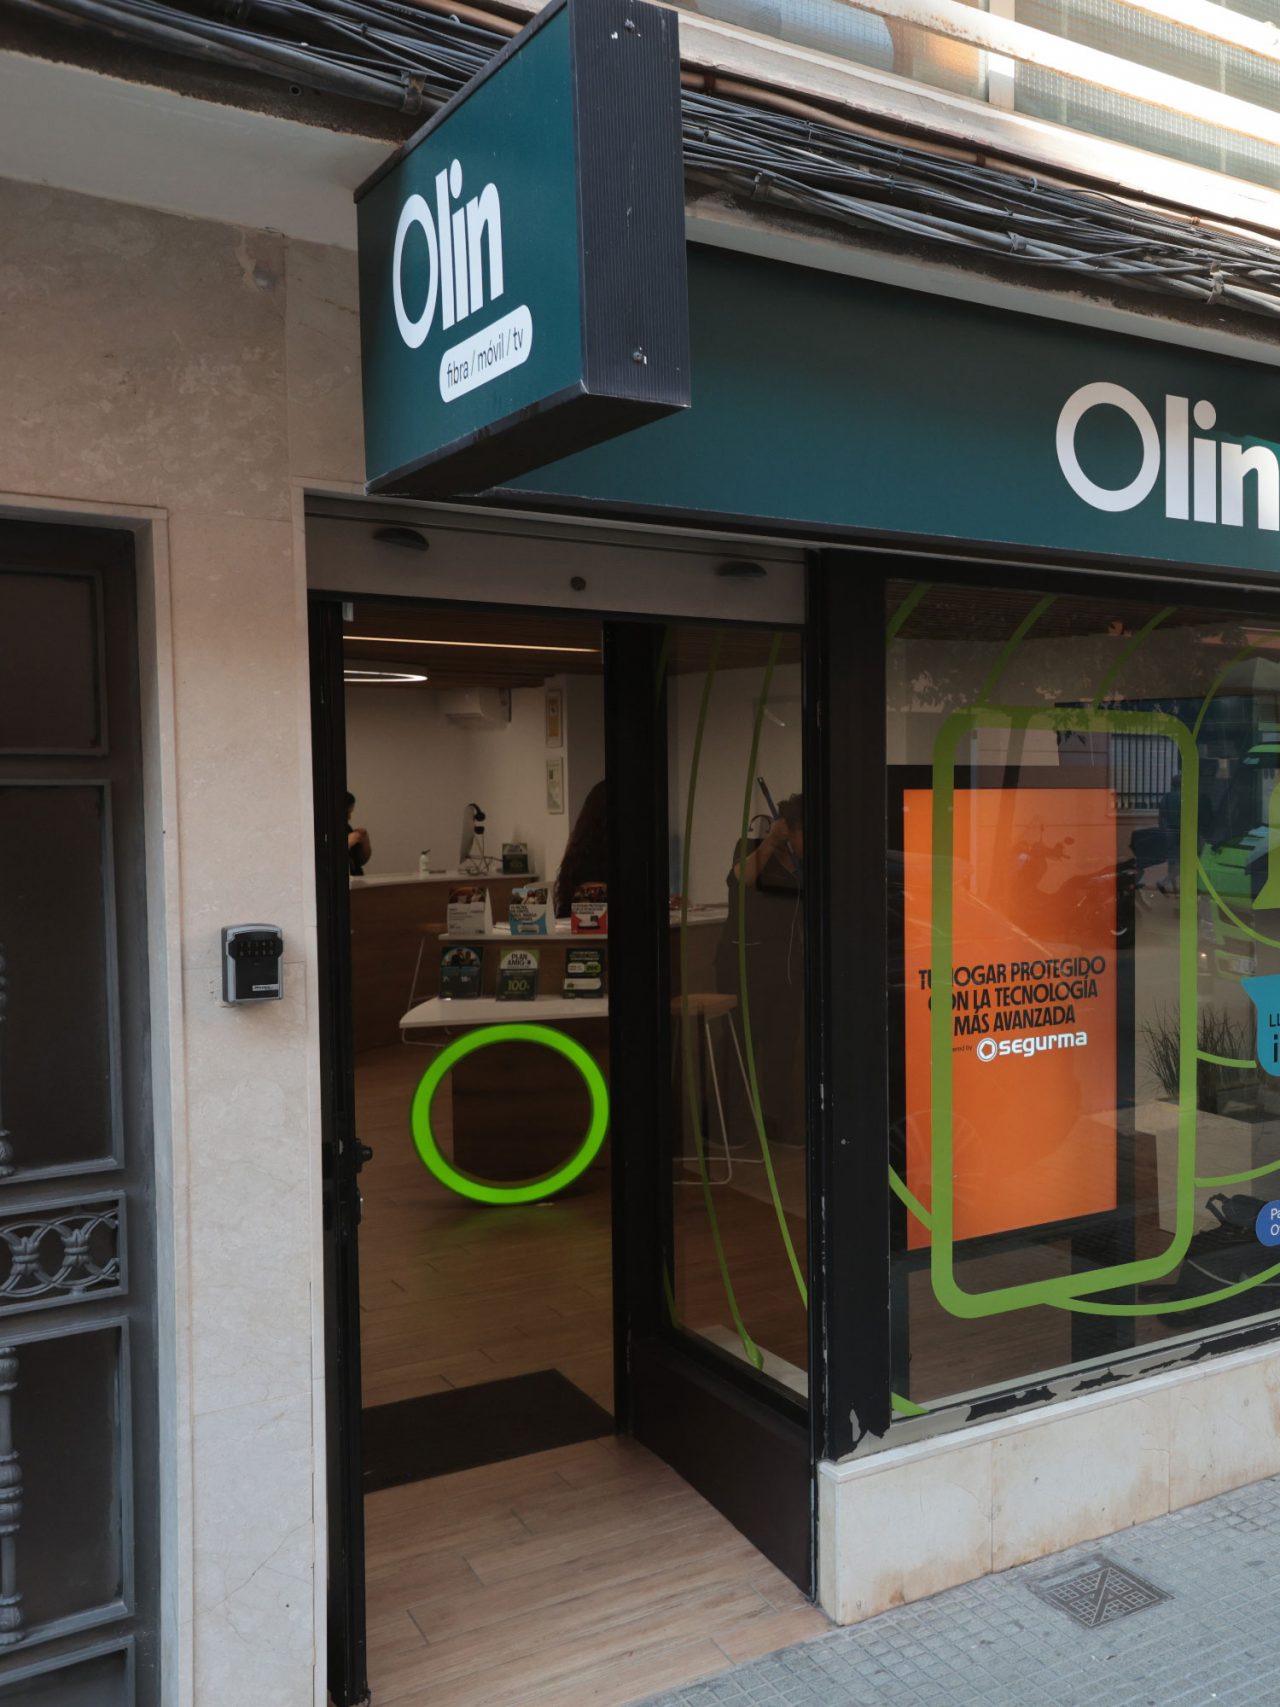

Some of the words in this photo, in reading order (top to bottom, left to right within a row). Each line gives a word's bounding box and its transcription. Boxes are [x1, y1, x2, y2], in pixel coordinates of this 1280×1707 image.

[393, 158, 504, 349] Olin
[446, 361, 470, 388] fibra
[477, 333, 503, 371] móvil
[512, 327, 524, 352] tv
[1056, 382, 1280, 531] Olin
[951, 963, 1007, 988] OGAR
[1011, 955, 1106, 983] PROTEGIDO
[973, 988, 991, 1010] LA
[994, 976, 1098, 1008] TECNOLOGÍA
[954, 1007, 990, 1036] MÁS
[993, 1004, 1076, 1032] AVANZADA
[998, 1031, 1088, 1058] segurma
